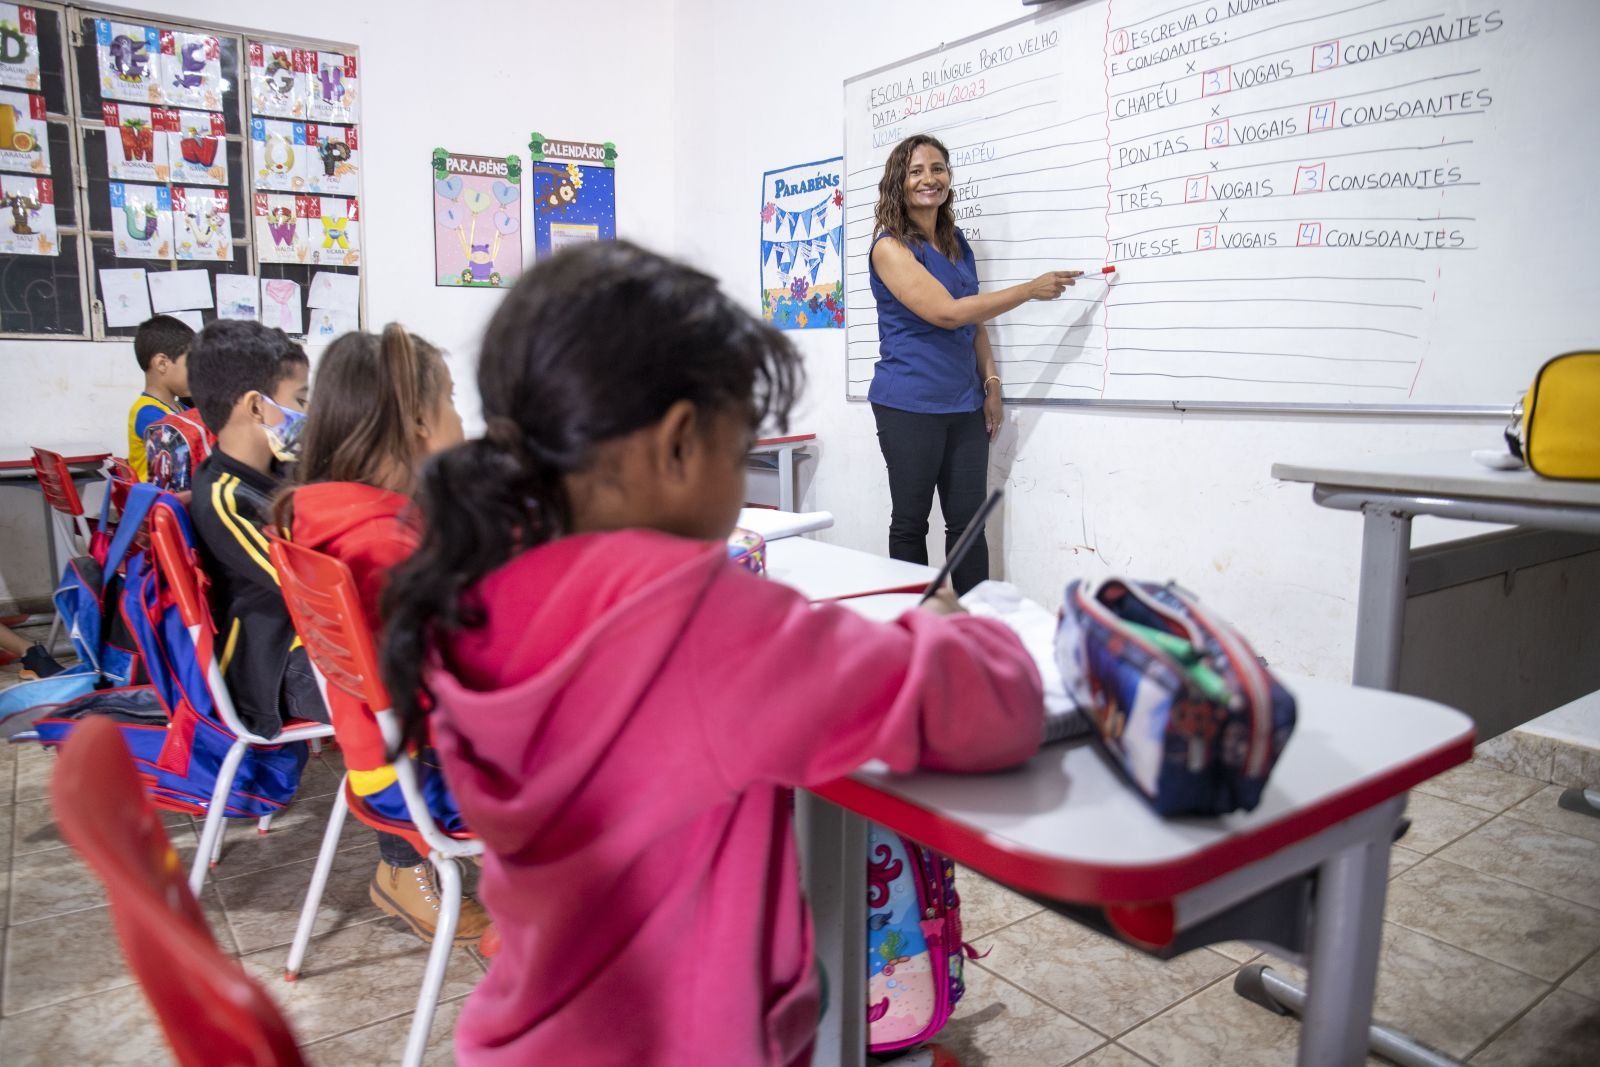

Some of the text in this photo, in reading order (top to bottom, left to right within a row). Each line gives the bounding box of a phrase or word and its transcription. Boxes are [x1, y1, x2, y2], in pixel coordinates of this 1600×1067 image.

[1132, 13, 1197, 49] ESCREVA
[1205, 7, 1218, 23] O
[1228, 0, 1280, 18] NUM
[870, 30, 1058, 108] ESCOLA BILÍNGUE PORTO VELHO
[1111, 32, 1227, 76] E CONSOANTES:
[1115, 81, 1177, 118] CHAPÉU
[1233, 60, 1294, 88] VOGAIS
[1343, 9, 1504, 65] CONSOANTES
[872, 78, 986, 127] DATA: 24/04/2023
[1119, 136, 1189, 168] PONTAS
[1233, 117, 1297, 144] VOGAIS
[1340, 88, 1493, 128] CONSOANTES
[445, 158, 509, 176] PARABÉNS
[541, 142, 606, 160] CALENDÁRIO
[953, 177, 980, 202] APÉU
[953, 203, 983, 220] NTAS
[1117, 184, 1163, 213] TRÊS
[1211, 179, 1274, 201] VOGAIS
[1328, 166, 1463, 192] CONSOANTES
[1112, 238, 1182, 261] TIVESSE
[1221, 232, 1278, 248] VOGAIS
[1325, 229, 1466, 249] CONSOANTES
